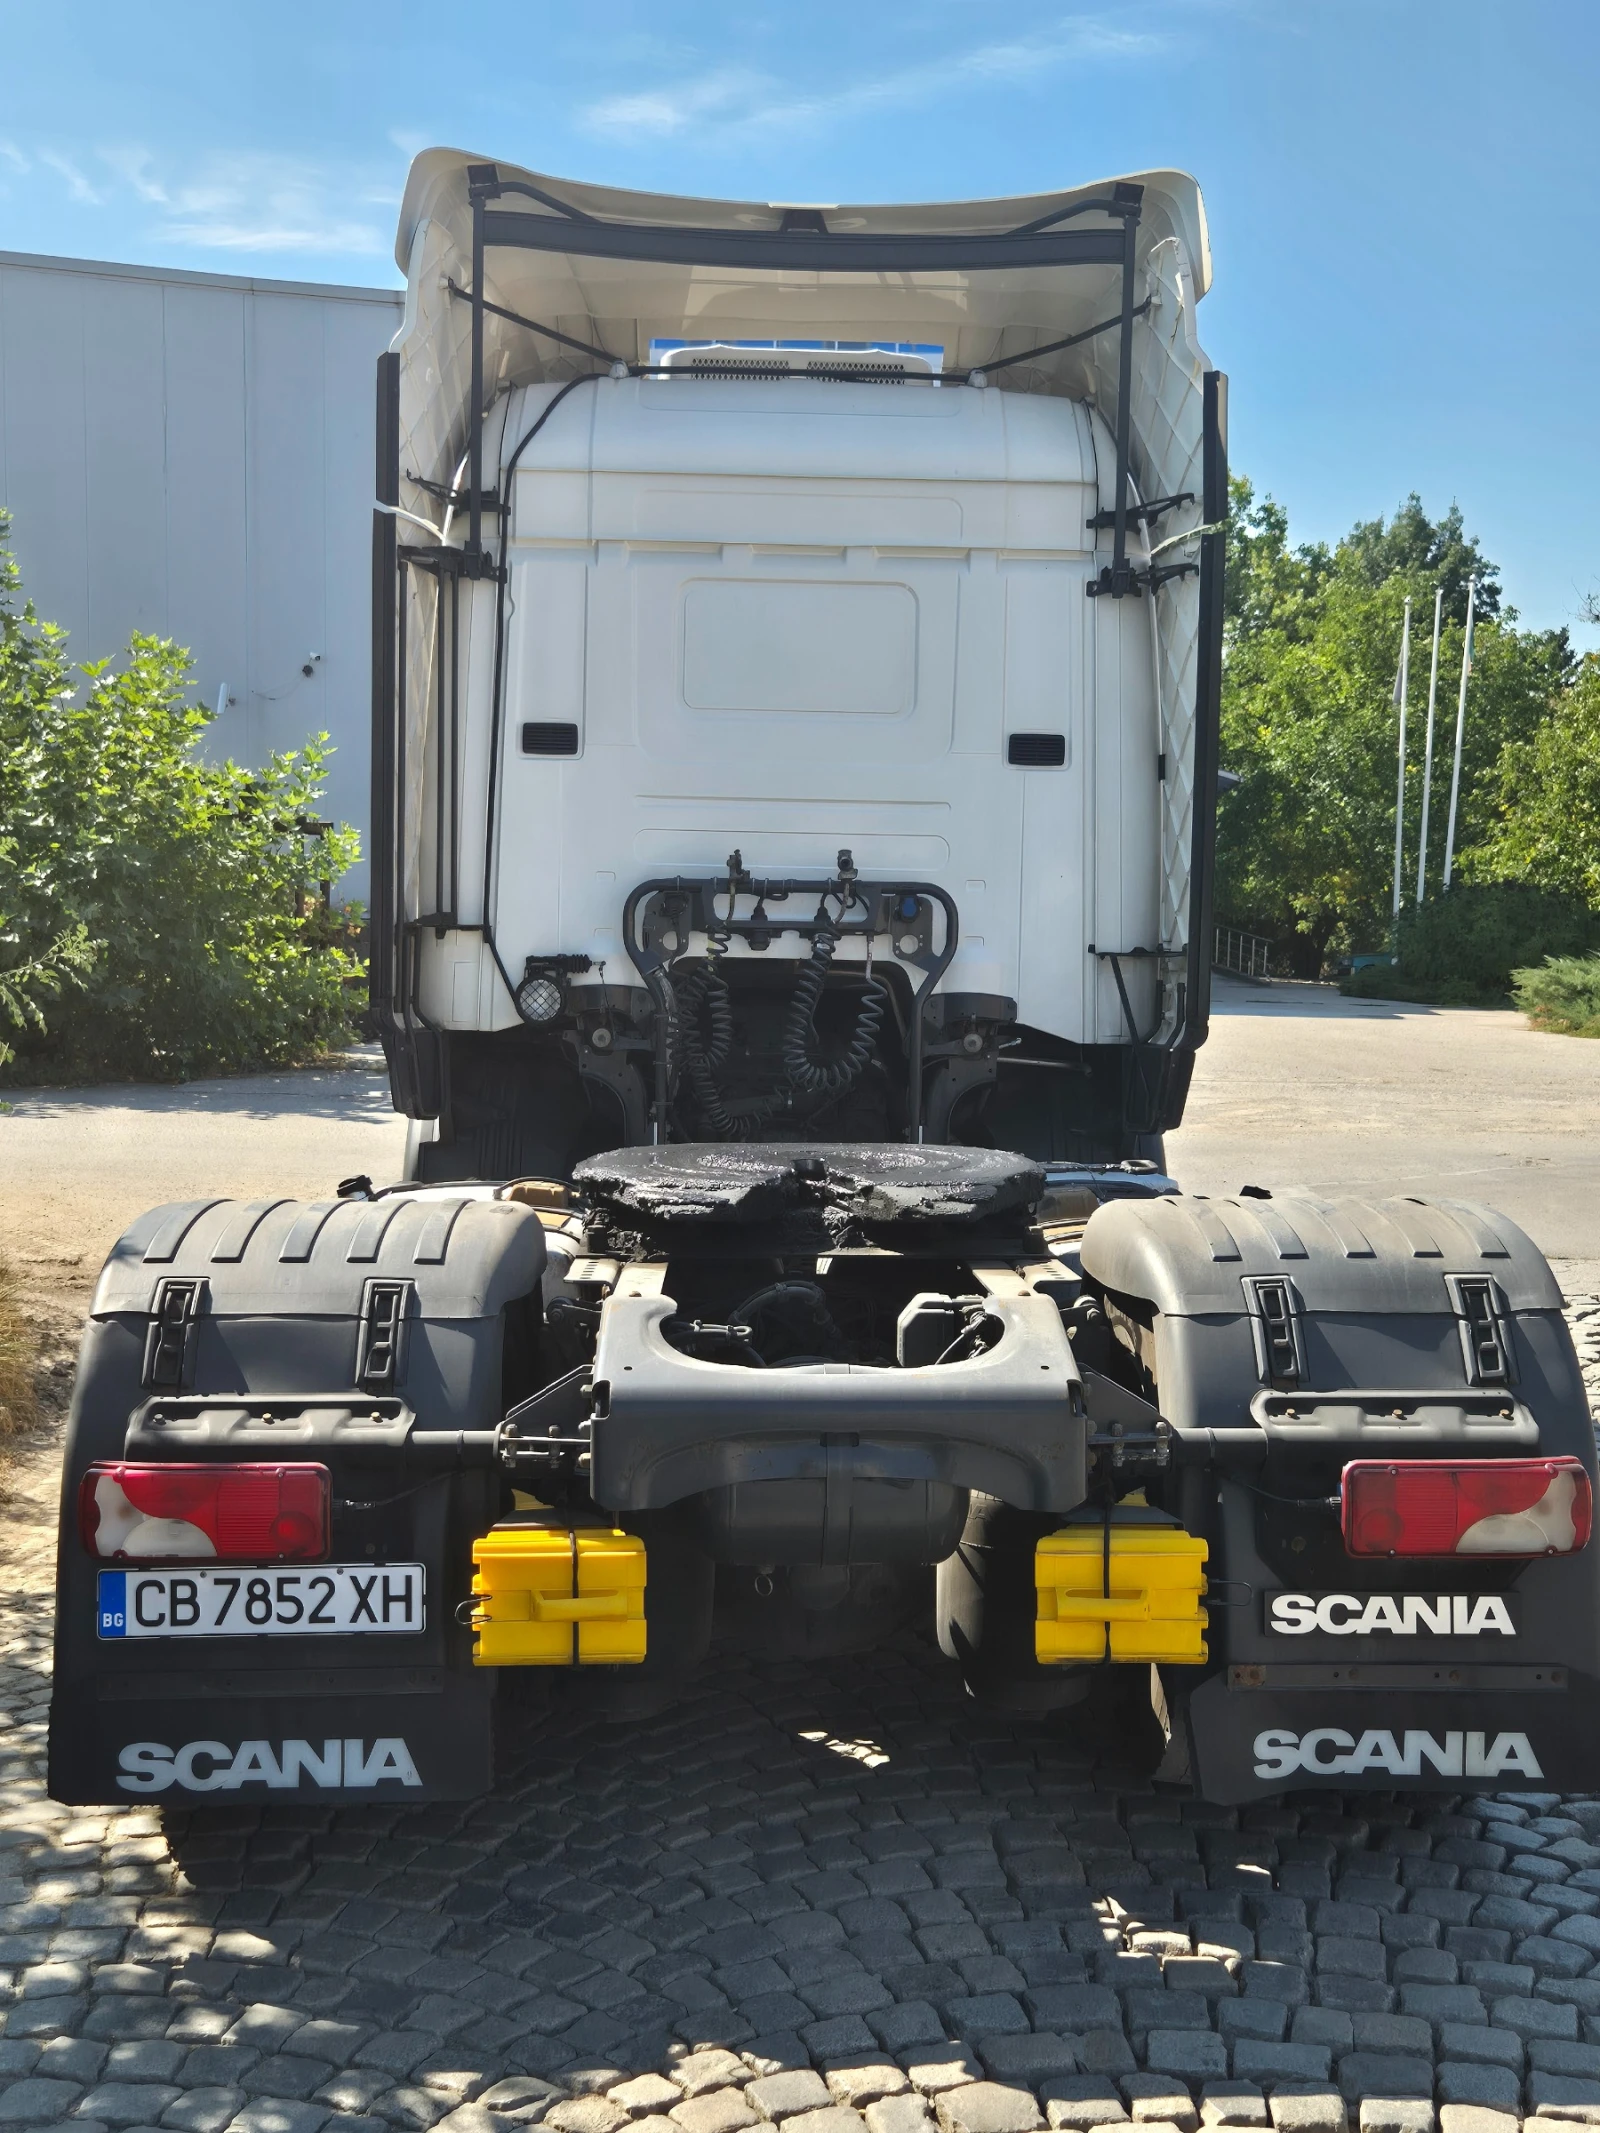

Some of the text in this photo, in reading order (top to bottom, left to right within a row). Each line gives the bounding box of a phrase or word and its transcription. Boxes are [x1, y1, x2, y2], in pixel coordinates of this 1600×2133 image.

[102, 1612, 124, 1628] BG
[1270, 1594, 1517, 1635] SCANIA
[115, 1737, 423, 1793] SCANIA
[1252, 1727, 1545, 1780] SCANIA
